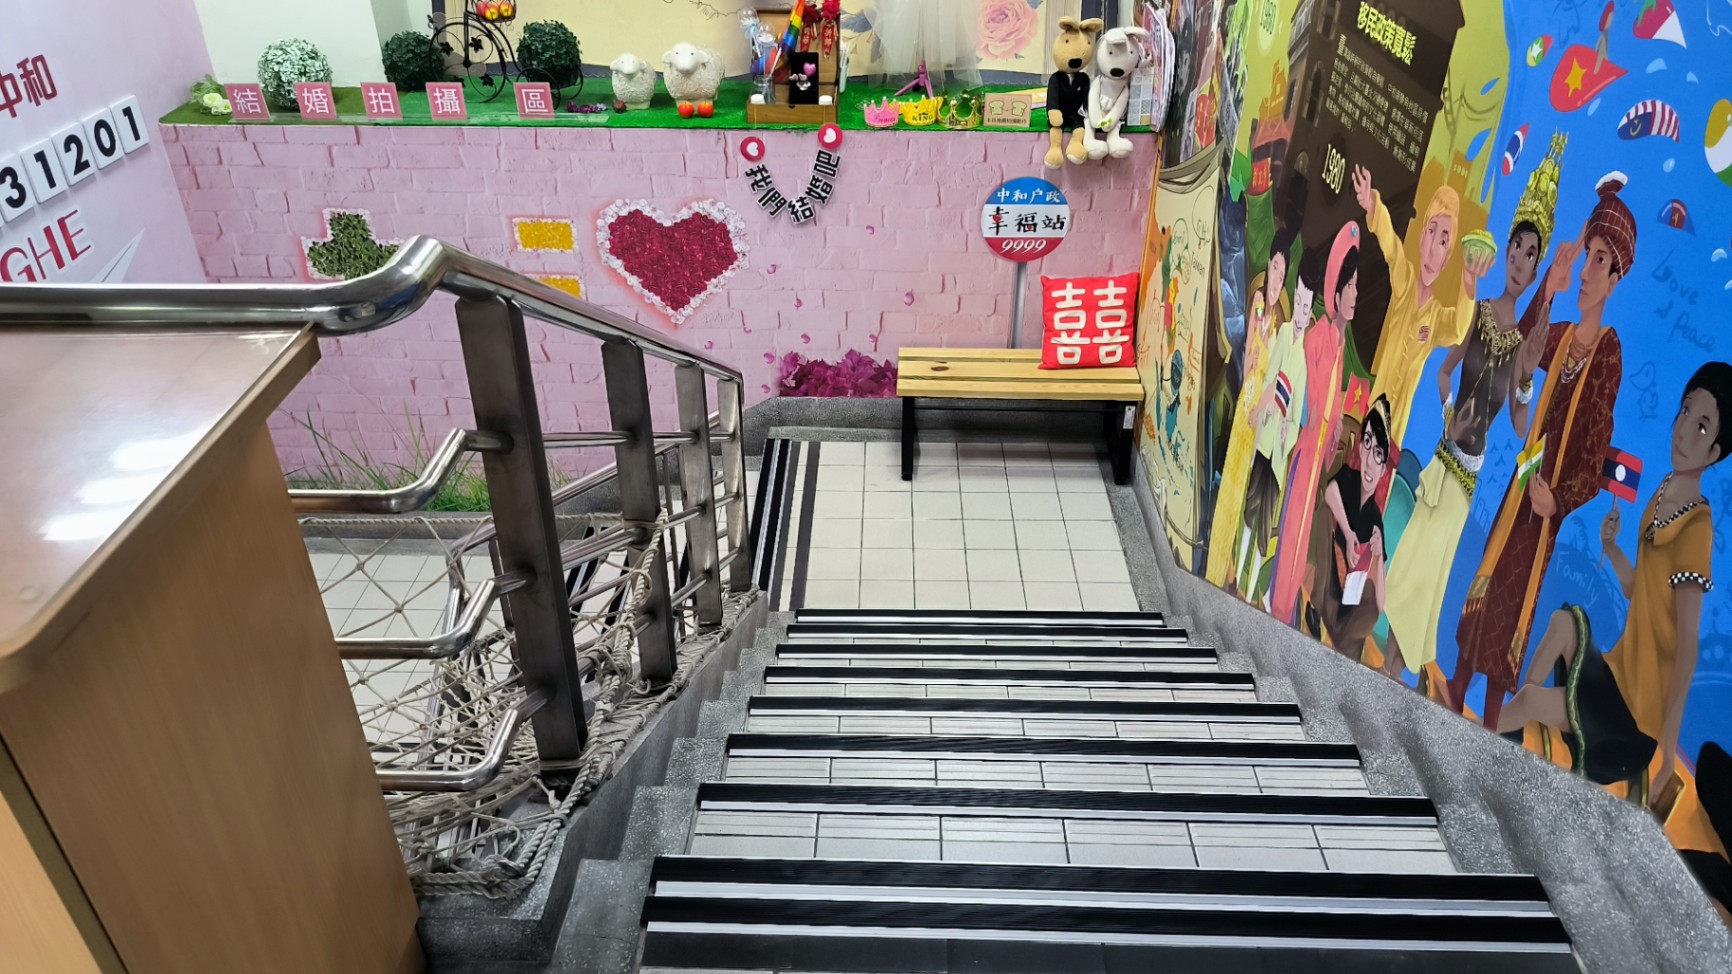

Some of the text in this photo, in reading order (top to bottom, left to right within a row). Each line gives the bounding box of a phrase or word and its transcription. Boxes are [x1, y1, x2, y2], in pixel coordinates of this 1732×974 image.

[1357, 1, 1417, 66] 移民政策寬鬆
[0, 54, 58, 118] 中和
[232, 87, 545, 115] 結婚拍攝區
[745, 150, 840, 223] 我們結婚吧
[1321, 144, 1346, 194] 1980
[989, 206, 1066, 236] 幸福站
[1000, 239, 1047, 254] 9999
[1651, 247, 1701, 306] Love
[1556, 551, 1598, 608] Family
